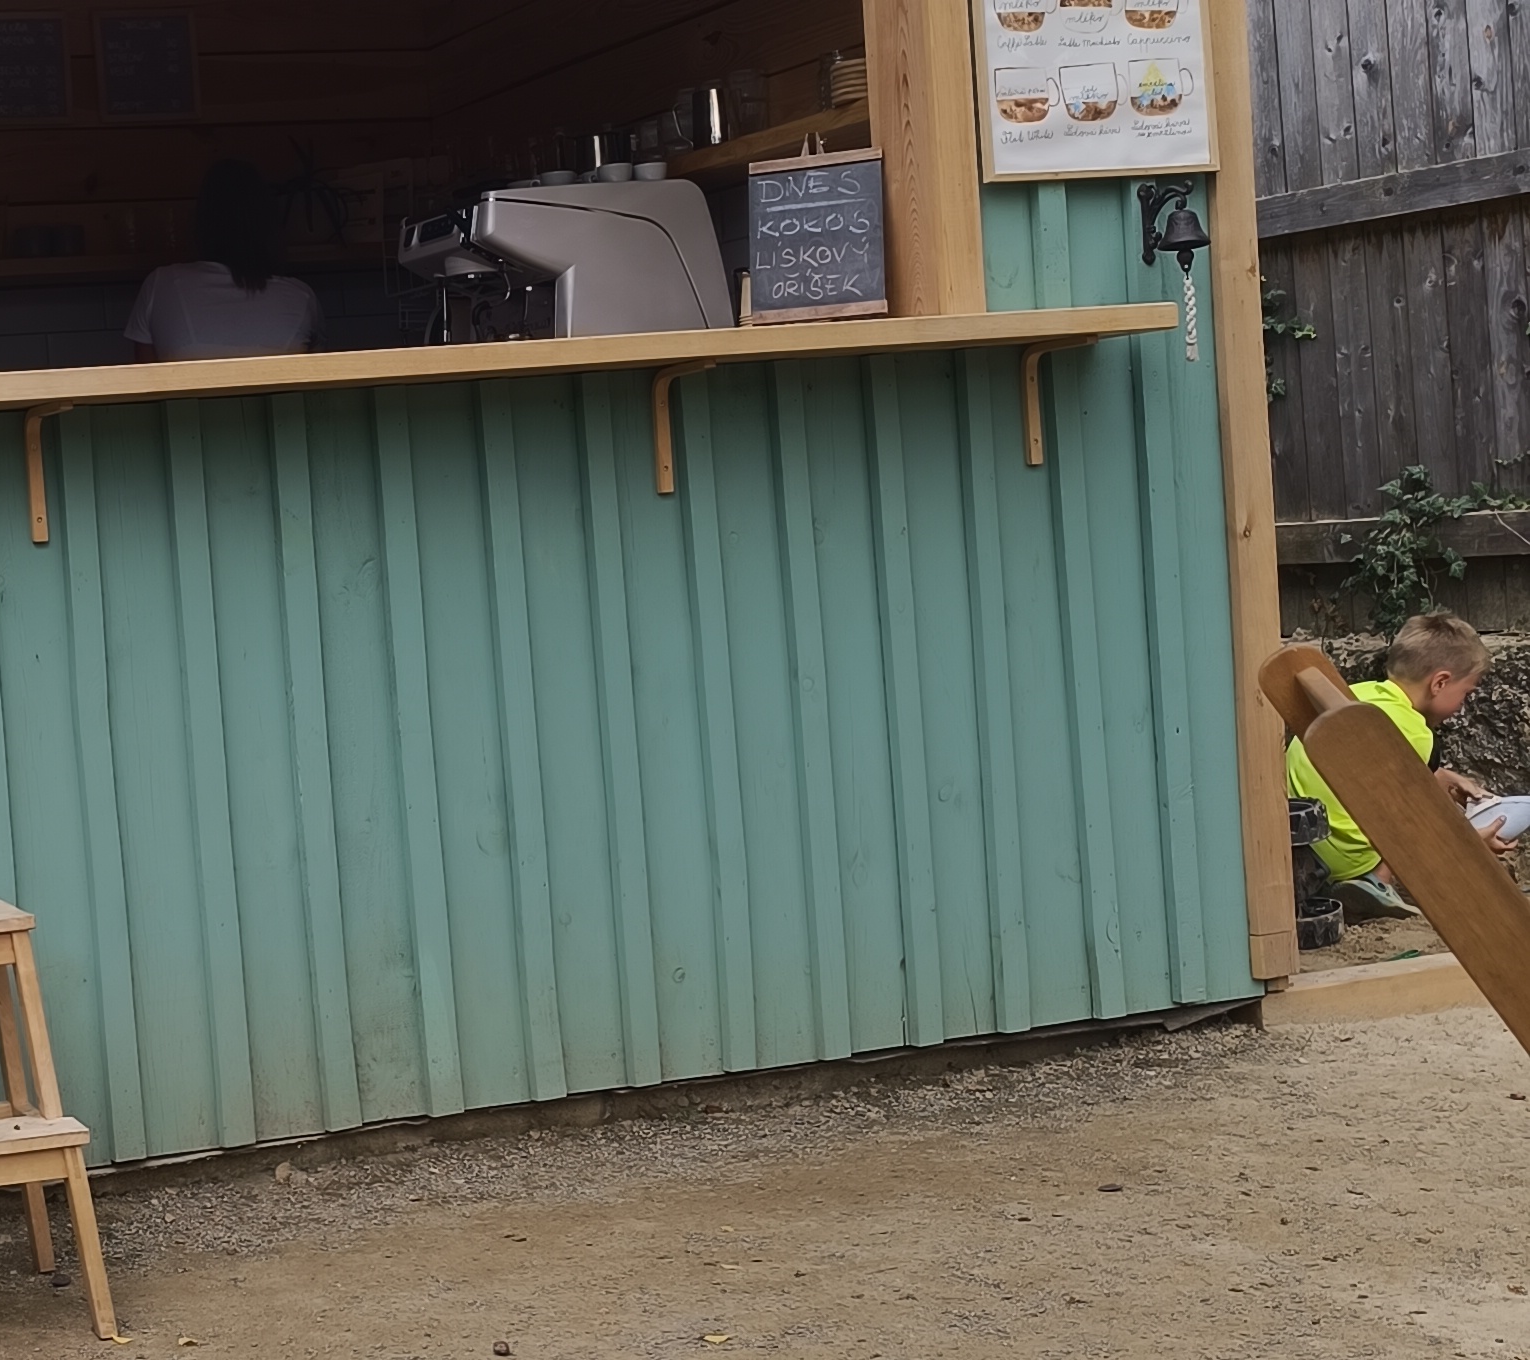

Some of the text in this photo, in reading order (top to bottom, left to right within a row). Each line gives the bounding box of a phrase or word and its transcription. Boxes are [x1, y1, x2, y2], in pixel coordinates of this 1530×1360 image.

[757, 170, 862, 203] DNES
[758, 210, 870, 239] KOKOS
[755, 237, 870, 269] LÍSKOVÝ
[772, 268, 863, 300] OŘÍŠEK
